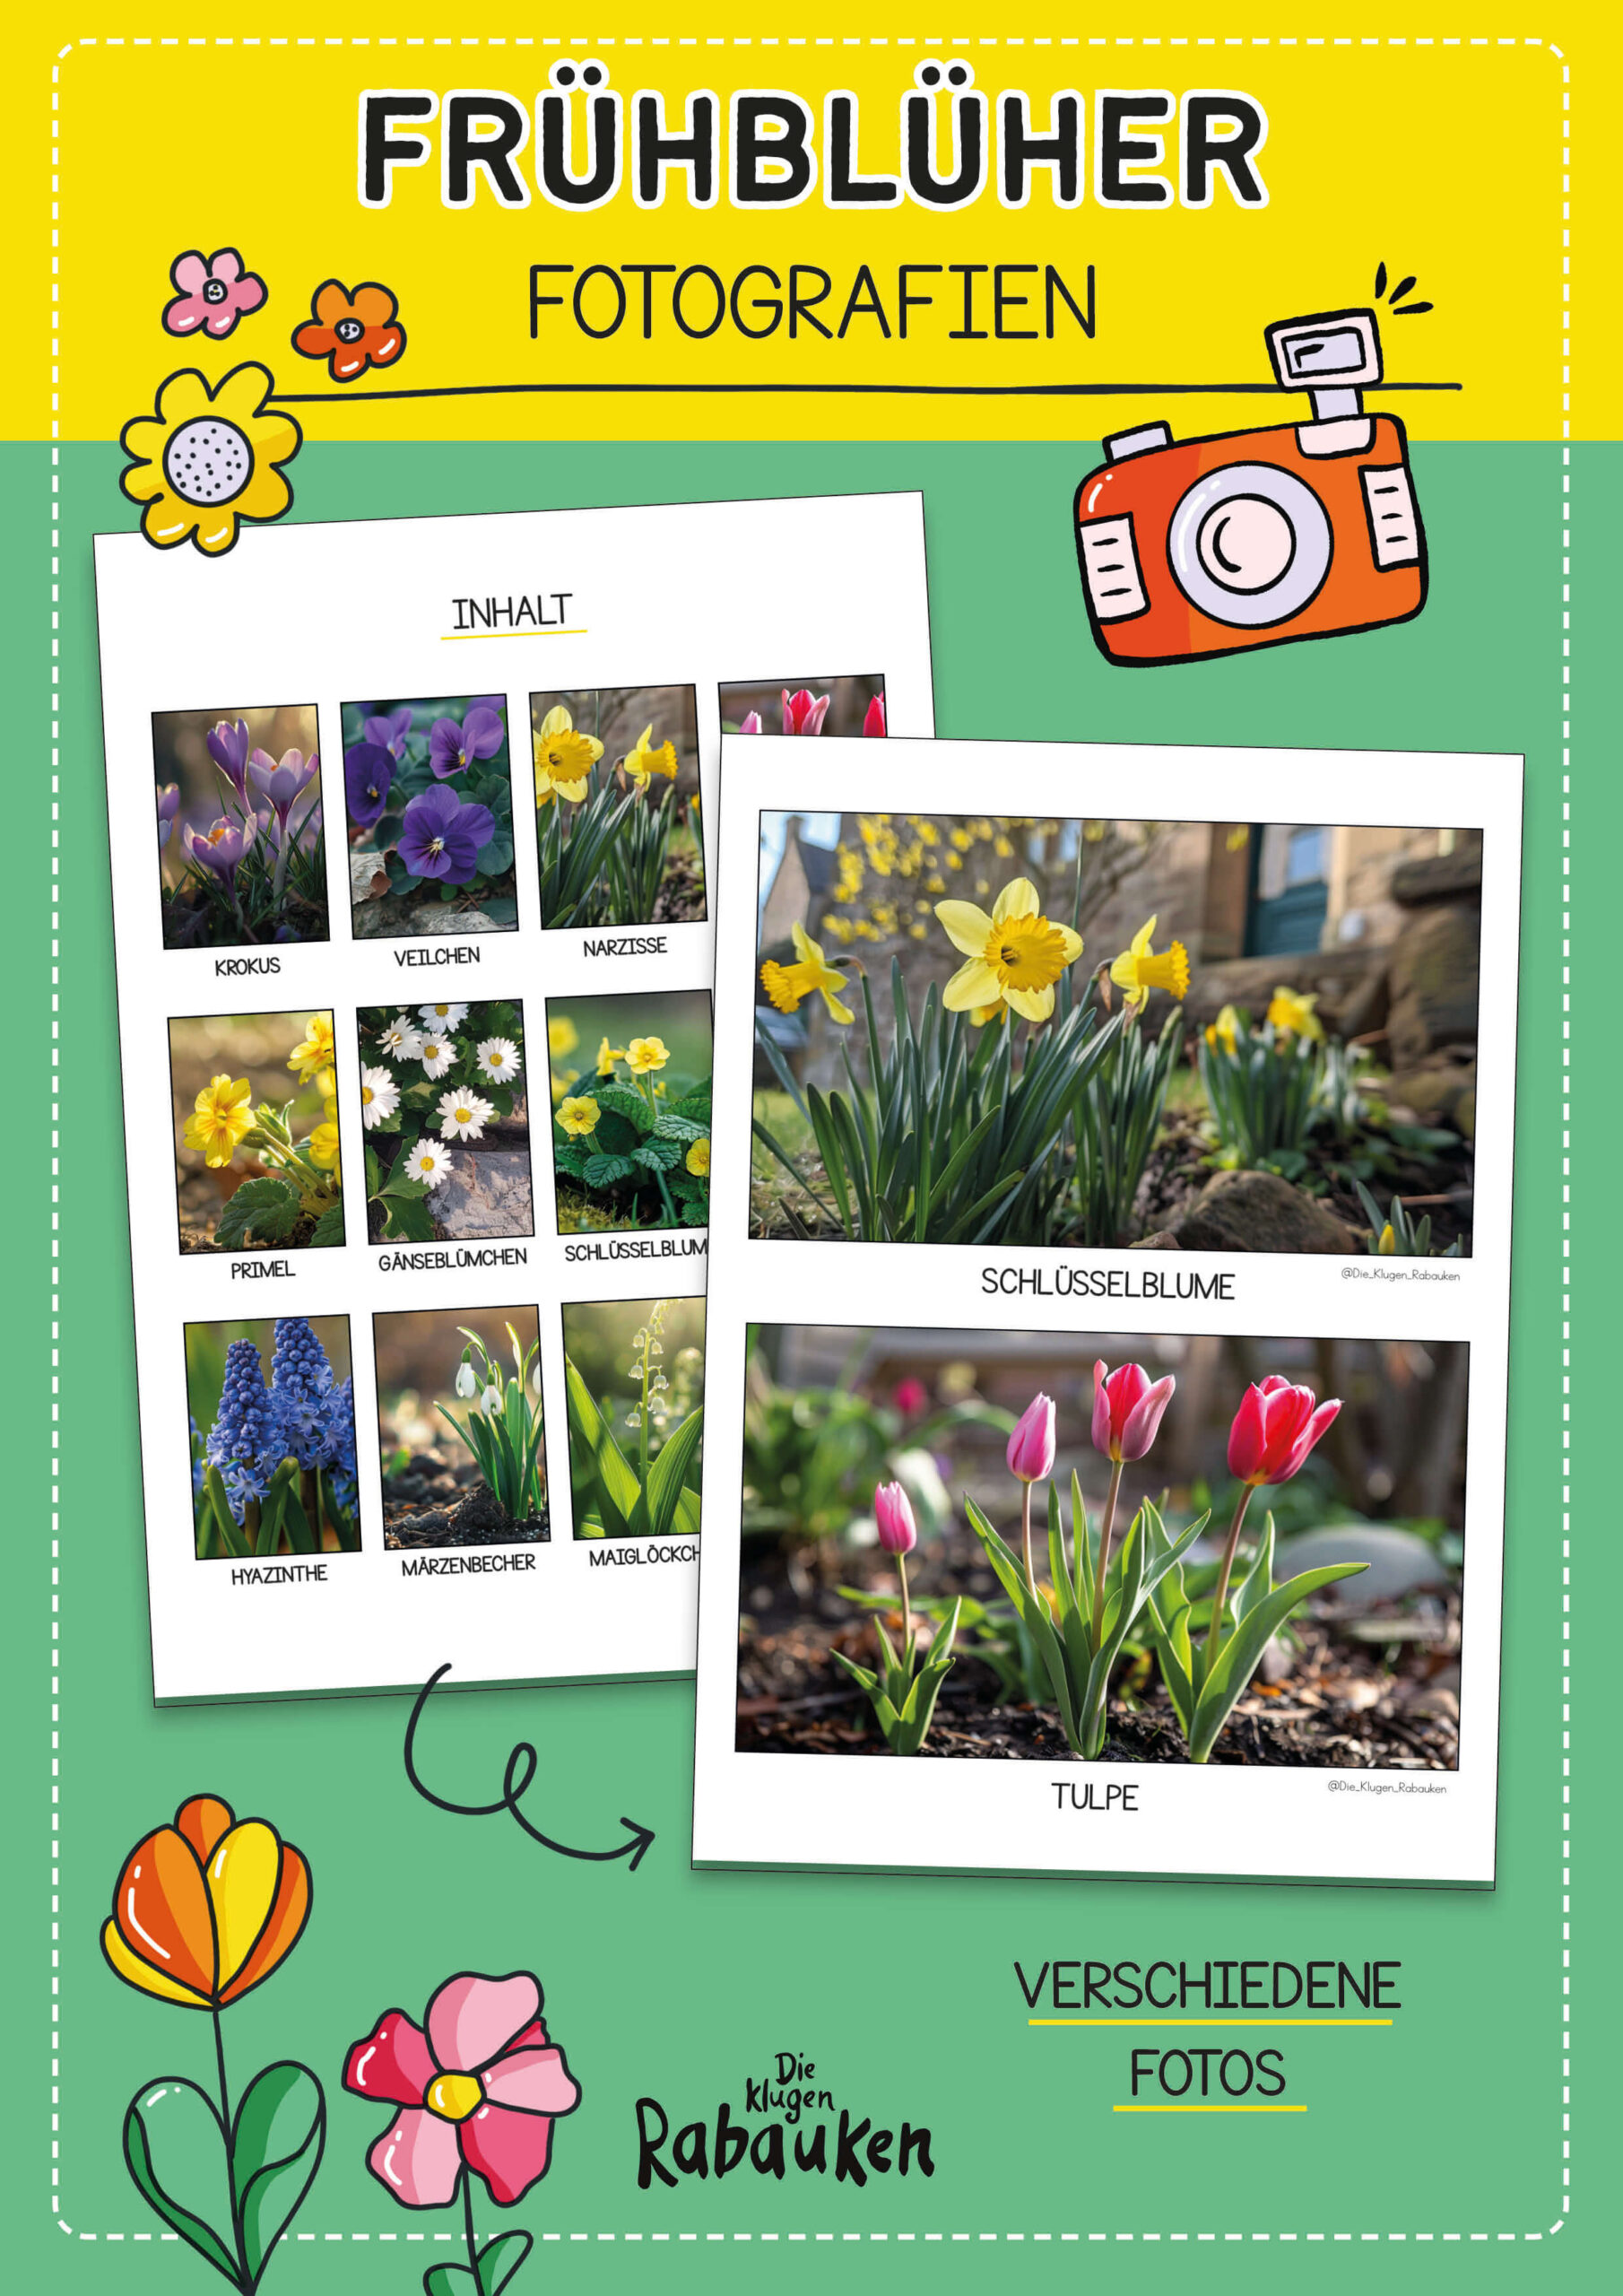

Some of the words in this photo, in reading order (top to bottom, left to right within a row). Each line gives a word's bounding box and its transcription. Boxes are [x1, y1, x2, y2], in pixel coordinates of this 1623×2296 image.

[364, 66, 1263, 205] FRÜHBLÜHER
[529, 265, 1097, 339] FOTOGRAFIEN
[452, 593, 573, 630] INHALT
[394, 946, 481, 967] VEILCHEN
[583, 935, 668, 958] NARZISSE
[214, 956, 282, 978] KROKUS
[378, 1246, 527, 1272] GÄNSEBLÜMCHEN
[565, 1239, 707, 1262] SCHLÜSSELBLUM
[230, 1259, 297, 1280] PRIMEL
[981, 1265, 1237, 1300] SCHLÜSSELBLUME
[1341, 1265, 1462, 1283] @Die_Klugen_Rabauken
[230, 1562, 328, 1586] HYAZINTHE
[401, 1551, 536, 1577] MÄRZENBECHER
[1051, 1782, 1140, 1812] TULPE
[1327, 1779, 1448, 1796] @Die_Klugen_Rabauken
[1013, 1961, 1402, 2009] VERSCHIEDENE
[774, 2052, 816, 2086] Die
[1131, 2048, 1287, 2097] FOTOS
[745, 2076, 836, 2125] klugen
[635, 2096, 935, 2190] Rabauken
